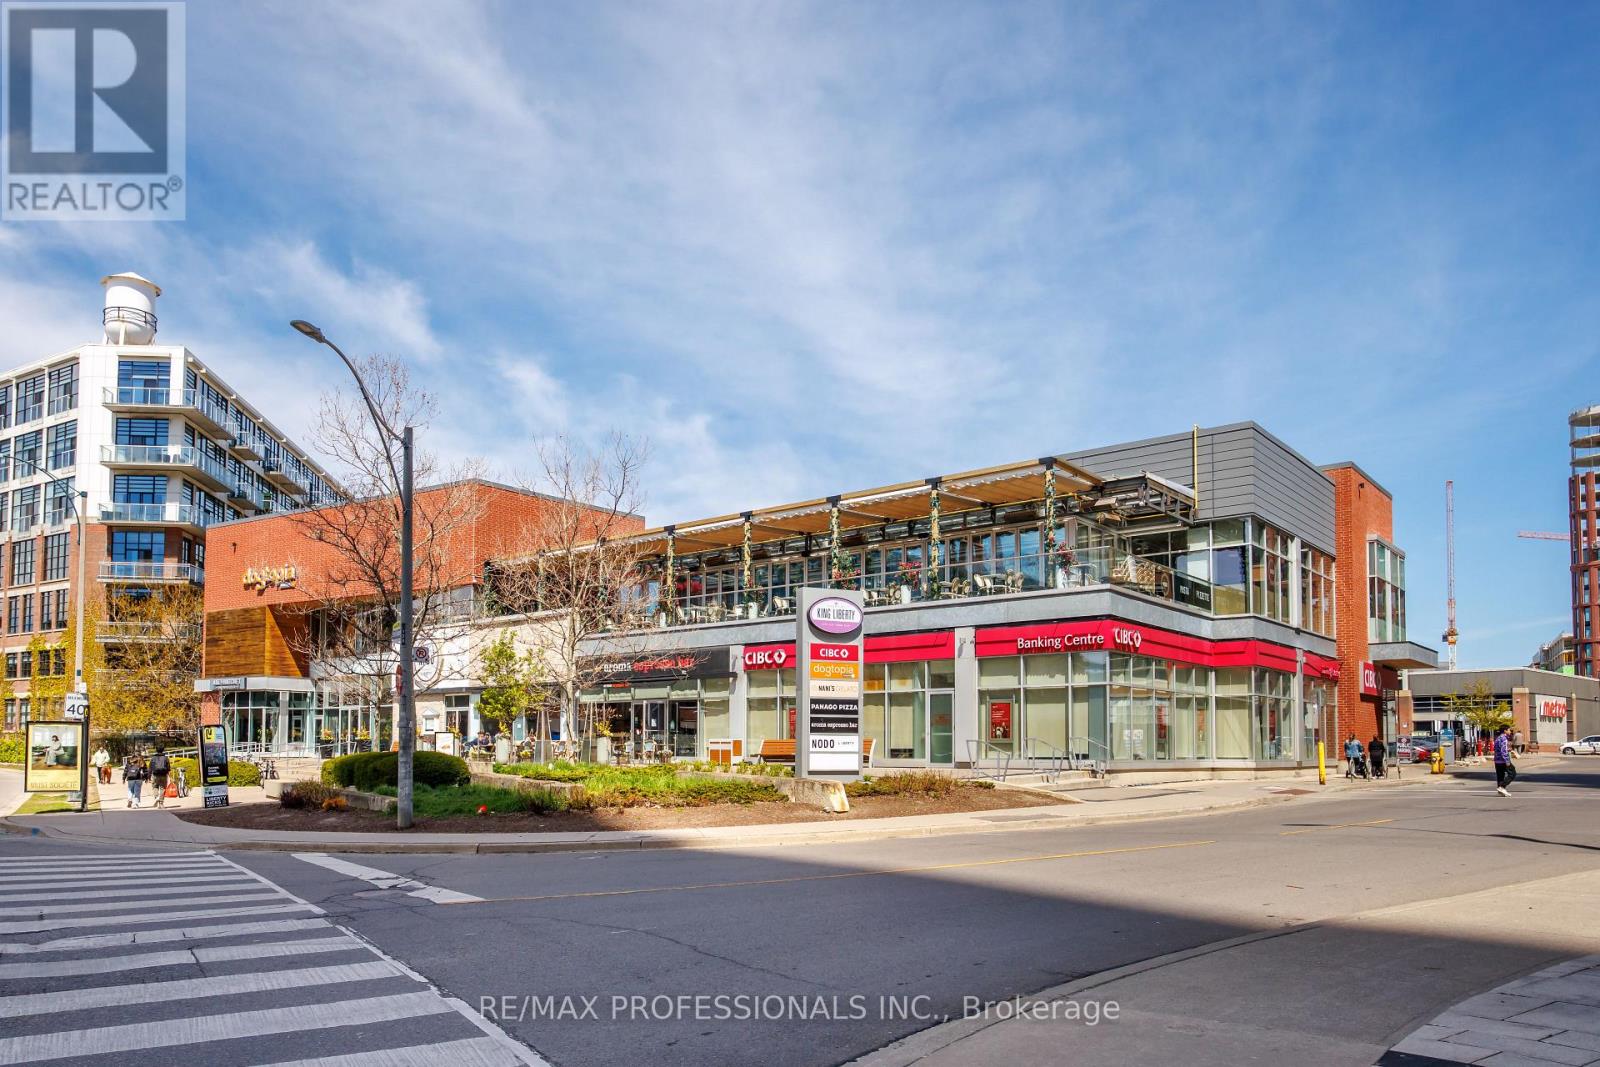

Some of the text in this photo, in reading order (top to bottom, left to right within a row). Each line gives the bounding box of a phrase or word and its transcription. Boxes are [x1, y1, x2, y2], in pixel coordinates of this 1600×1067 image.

[817, 607, 855, 620] KING LIBERTY
[1017, 634, 1105, 649] Banking Centre
[1114, 628, 1135, 646] CIBC
[745, 650, 773, 665] CIBC
[820, 648, 840, 658] CIBC
[813, 663, 854, 677] dogtopia
[67, 703, 85, 716] 40
[1541, 700, 1569, 719] metro
[812, 739, 835, 749] NODO
